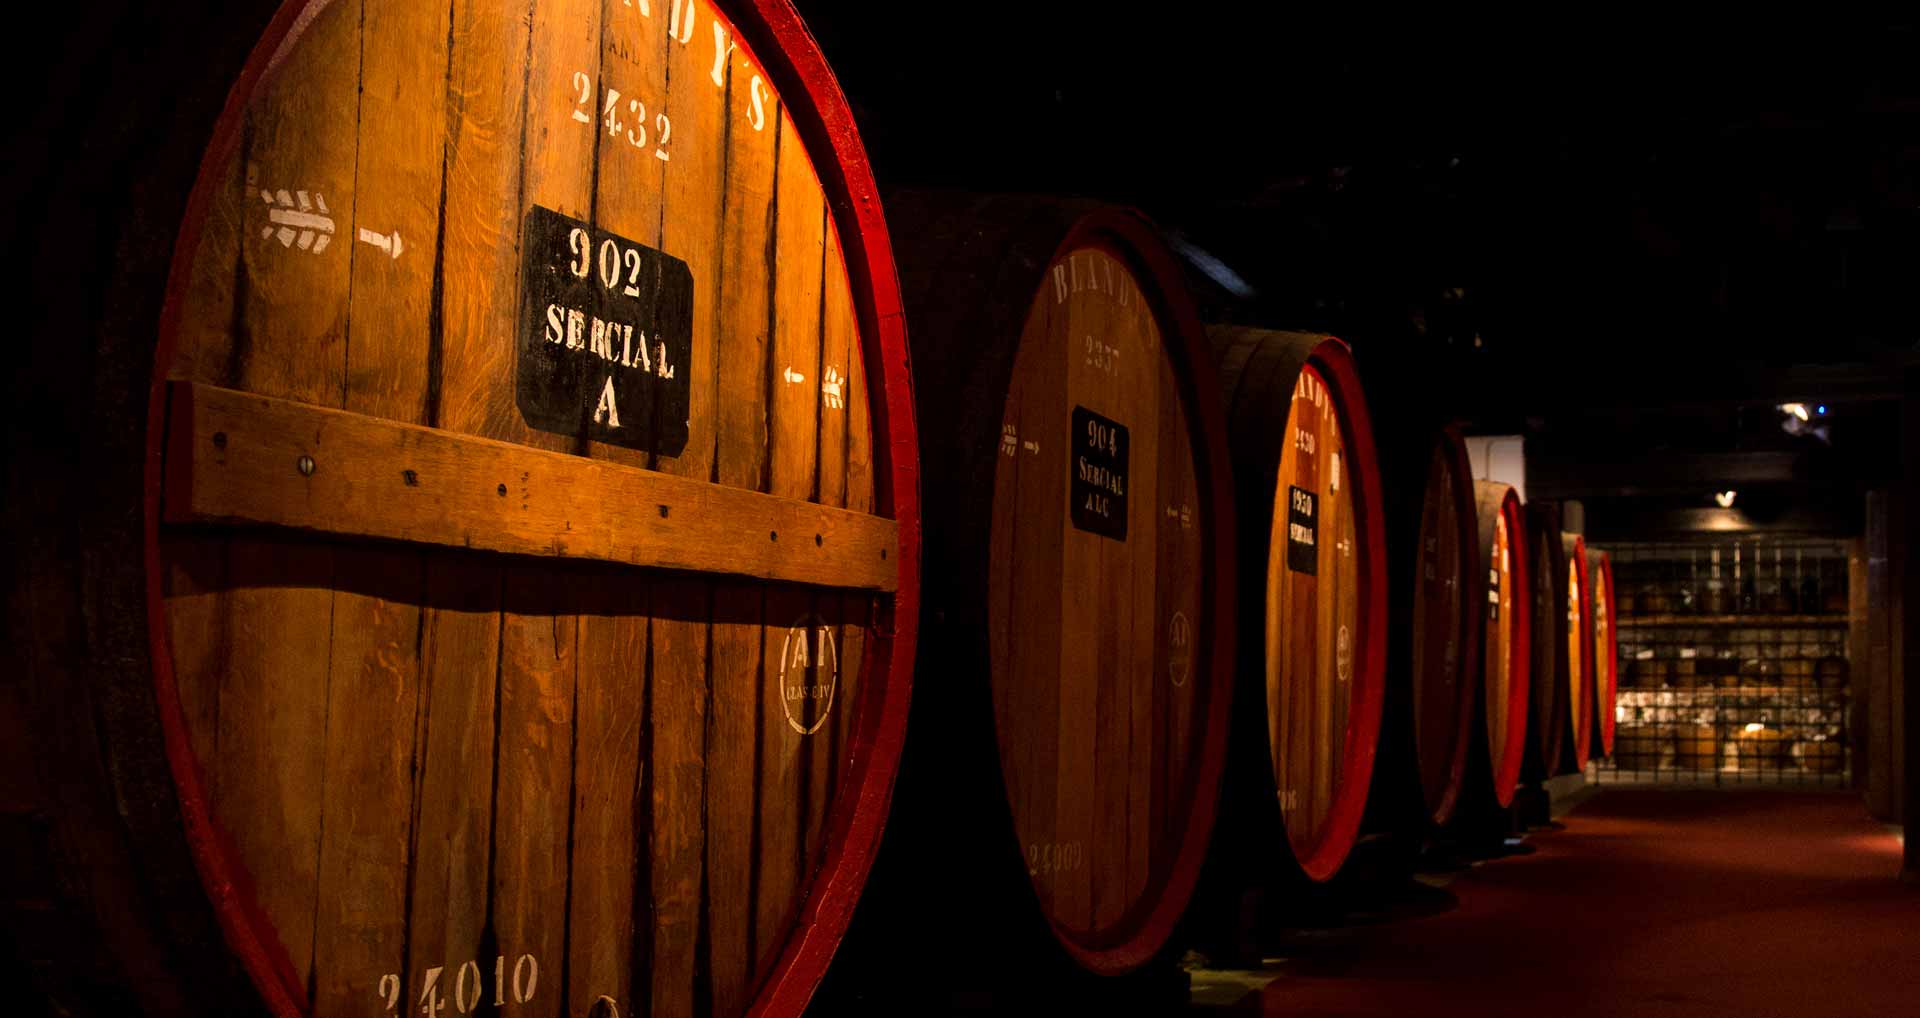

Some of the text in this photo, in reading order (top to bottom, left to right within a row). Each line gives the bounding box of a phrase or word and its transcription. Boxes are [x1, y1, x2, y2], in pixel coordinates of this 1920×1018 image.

[572, 71, 672, 161] 2432
[569, 228, 641, 297] 902
[545, 303, 675, 379] SERCIAL
[593, 376, 621, 428] A
[1088, 419, 1118, 457] 904
[1079, 455, 1124, 496] SERCIAL
[379, 953, 538, 1018] 24010
